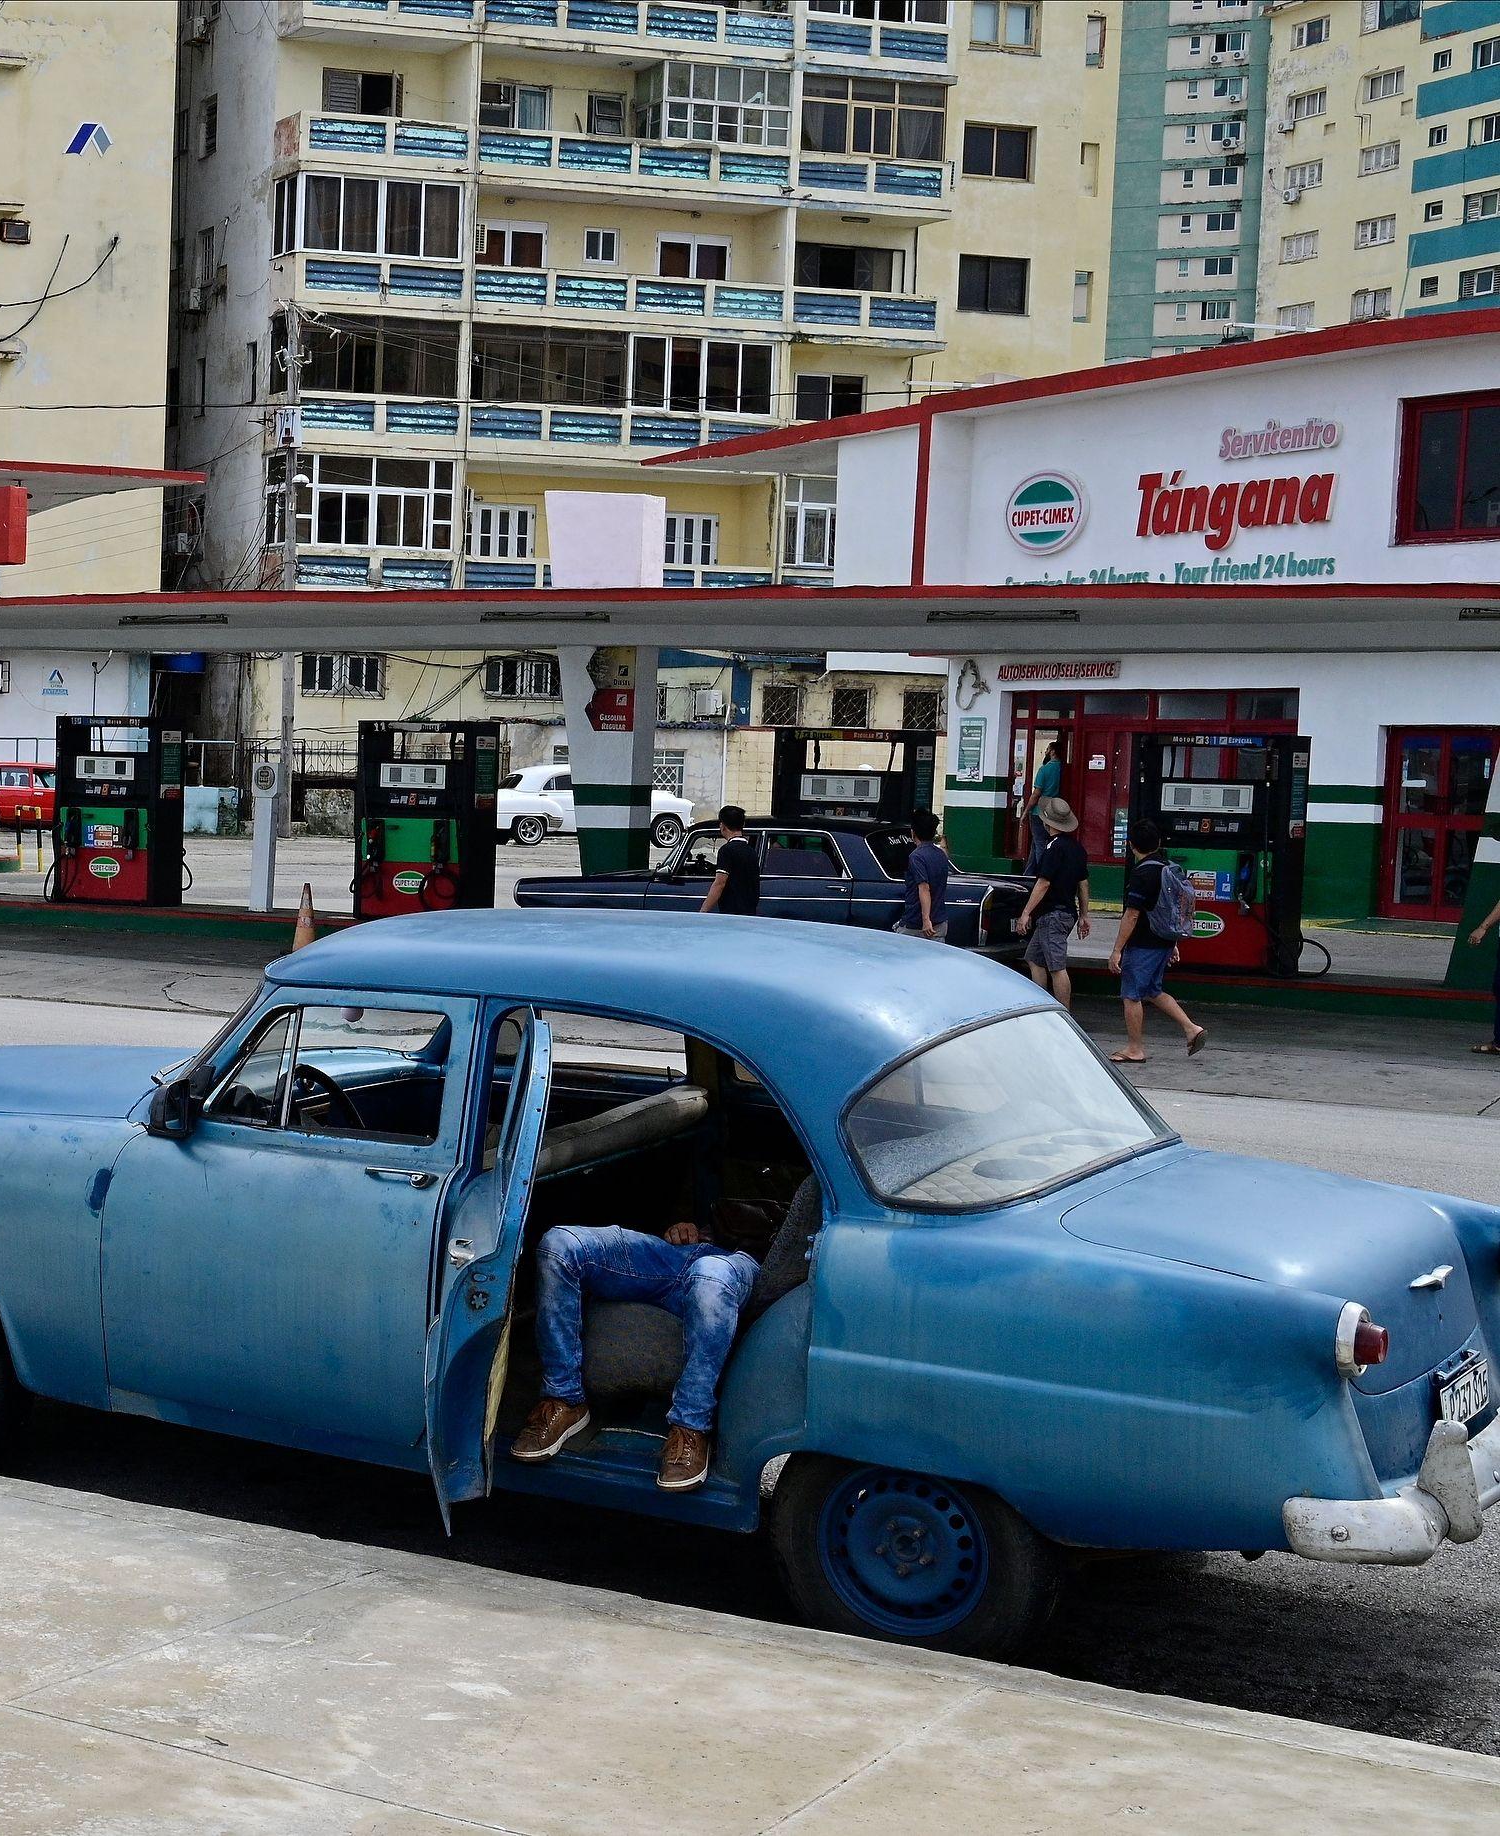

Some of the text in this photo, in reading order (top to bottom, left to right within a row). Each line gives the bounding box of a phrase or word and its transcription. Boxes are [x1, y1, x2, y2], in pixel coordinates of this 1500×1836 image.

[1219, 418, 1342, 460] Servicentro
[1011, 505, 1075, 527] CUPET-CIMEX
[1136, 469, 1339, 551] Tángana
[1174, 551, 1336, 584] Your friend 24 hours
[998, 662, 1115, 680] AUTO SERVICIO SELF SERVICE
[601, 723, 626, 731] REGULAR
[1204, 736, 1210, 745] 3
